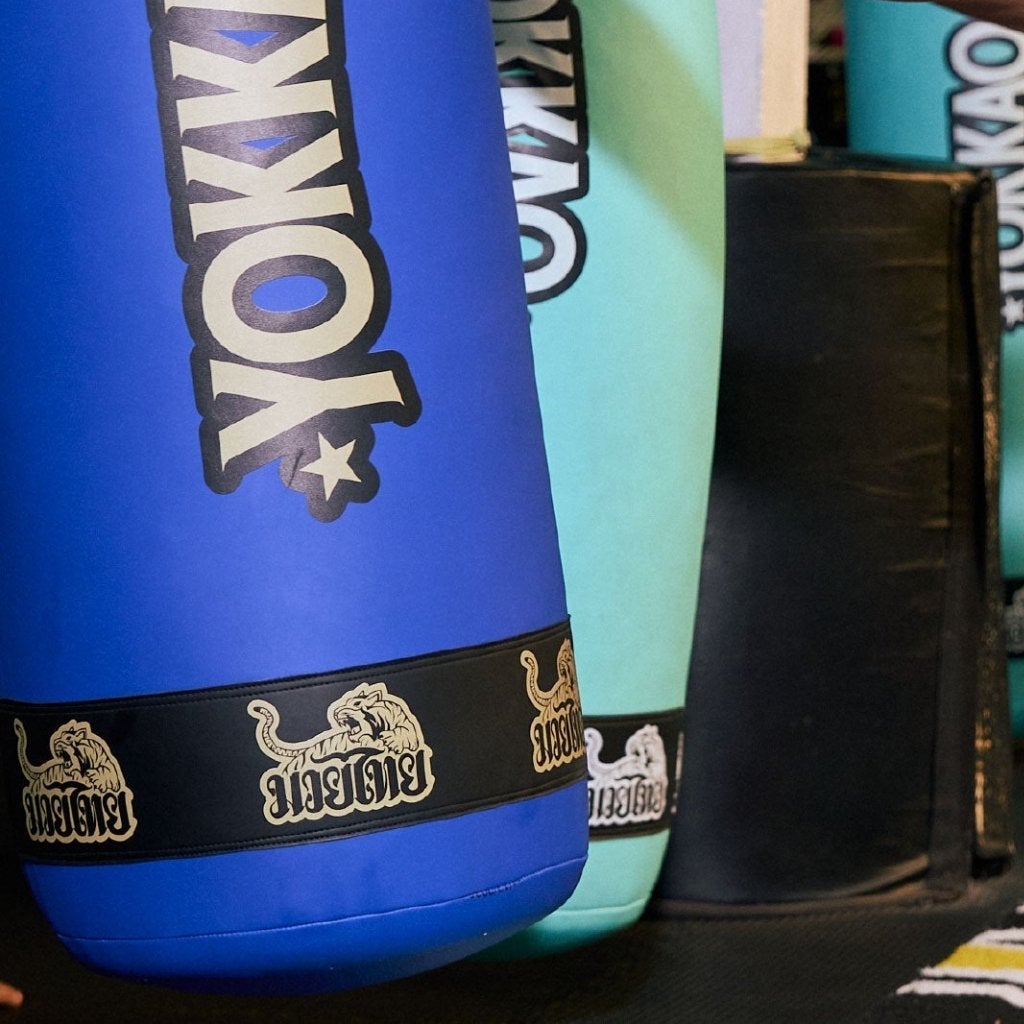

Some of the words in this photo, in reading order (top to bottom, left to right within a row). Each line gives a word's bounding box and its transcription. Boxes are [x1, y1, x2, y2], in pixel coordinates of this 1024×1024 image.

[24, 780, 133, 837] มวยไทย
[265, 746, 429, 820] มวยไทย
